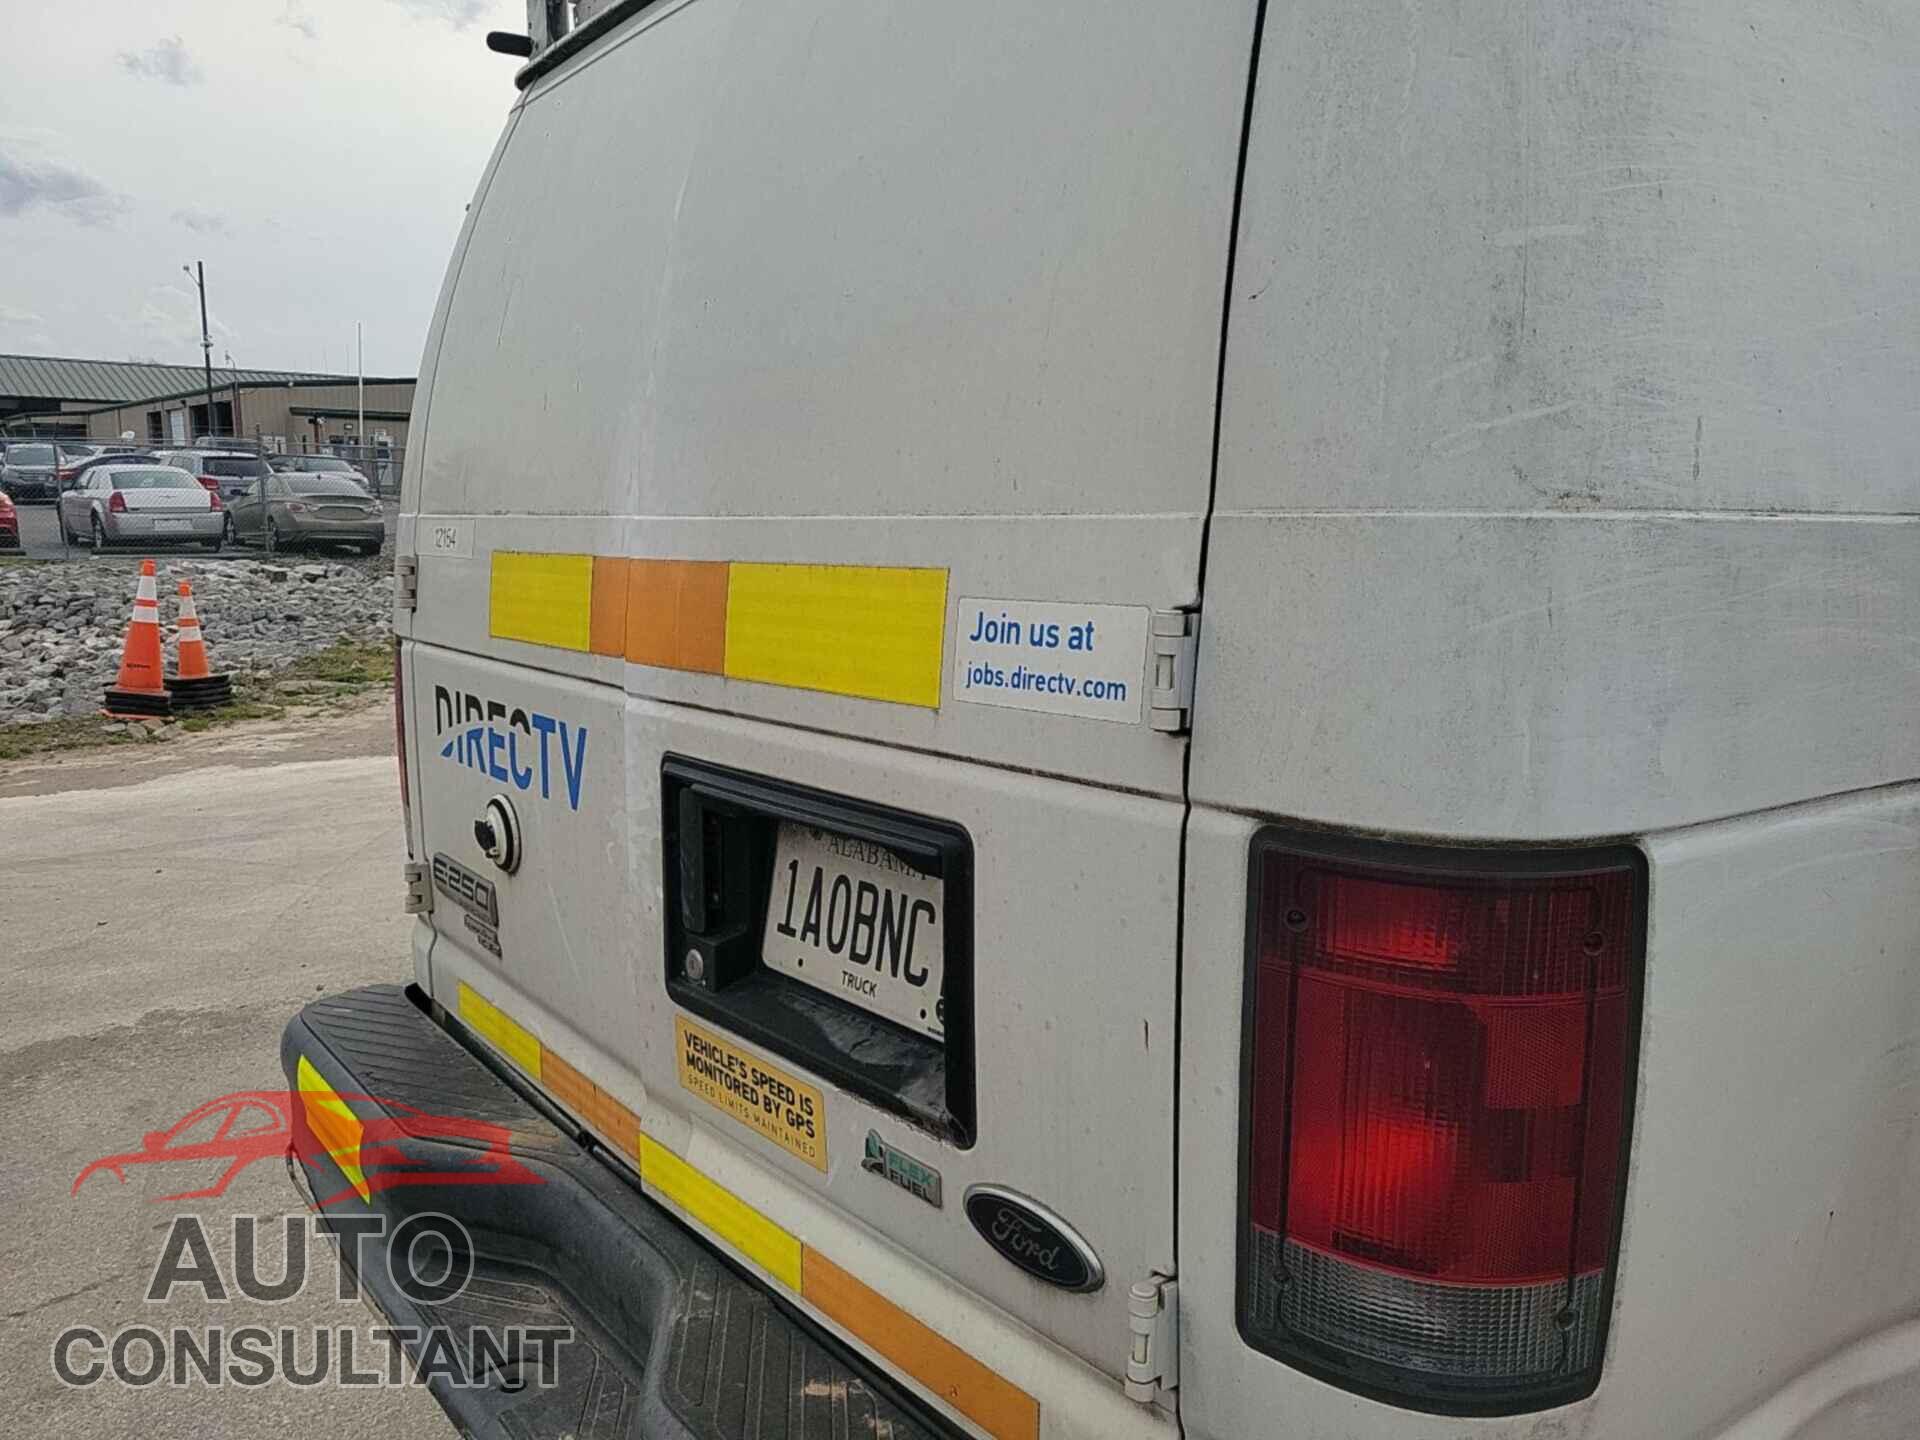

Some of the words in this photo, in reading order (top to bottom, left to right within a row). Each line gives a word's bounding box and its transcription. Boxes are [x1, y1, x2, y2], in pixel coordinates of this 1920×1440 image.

[969, 611, 1021, 645] Join
[1029, 622, 1060, 649] us
[1067, 620, 1095, 651] at
[966, 660, 1127, 702] jobs.directv.com
[434, 684, 588, 812] DIRECTV
[826, 835, 927, 881] ALABAM
[841, 970, 878, 999] TRUCK
[683, 1029, 749, 1080] VEHICLE'S
[750, 1067, 796, 1106] SPEED
[799, 1093, 815, 1117] IS
[685, 1050, 760, 1106] MONITORED
[762, 1096, 782, 1119] BY
[785, 1107, 816, 1139] GPS
[687, 1073, 716, 1098] SPEED
[719, 1091, 751, 1119] LIMITS
[753, 1113, 817, 1158] MAINTAINED
[888, 1150, 937, 1185] FLEX
[990, 1206, 1060, 1271] Ford
